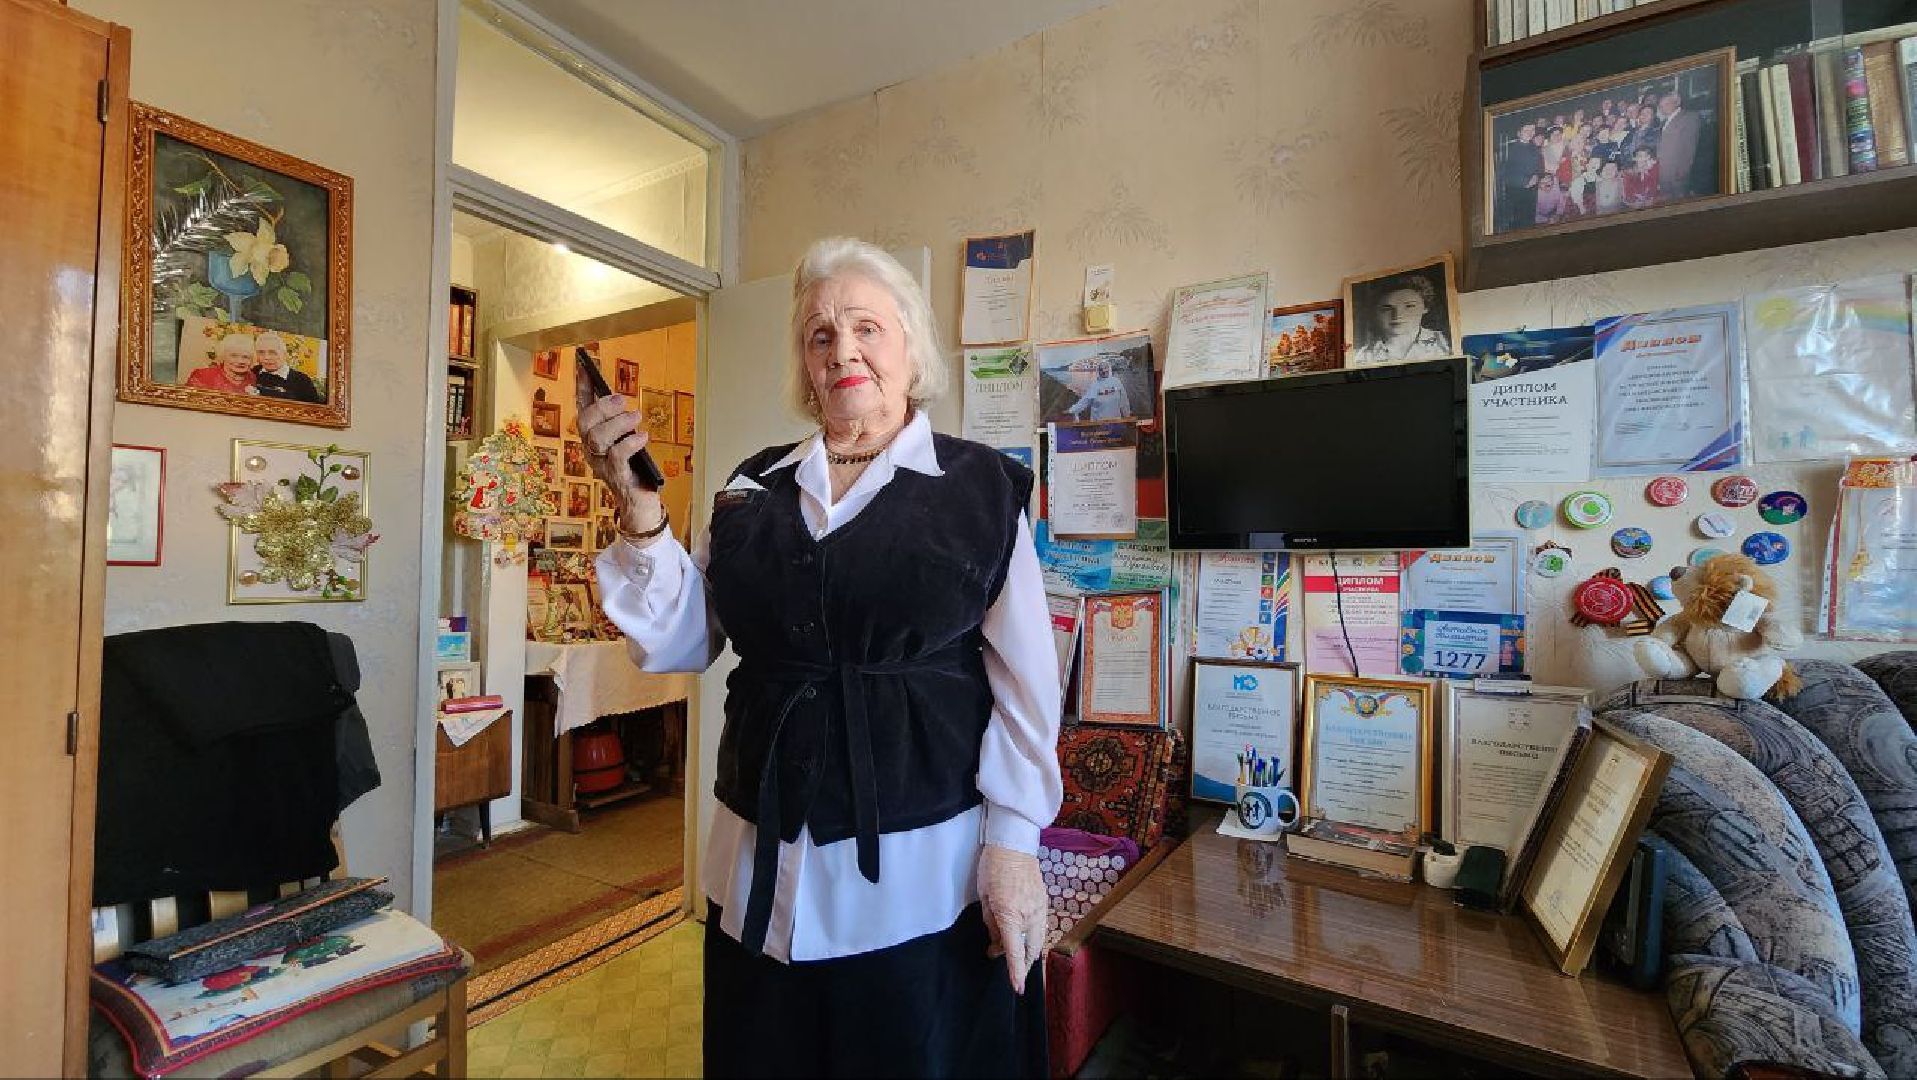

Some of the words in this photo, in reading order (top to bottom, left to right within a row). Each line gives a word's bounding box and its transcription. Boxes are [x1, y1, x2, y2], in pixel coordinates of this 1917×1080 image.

[1493, 382, 1557, 396] ДИПЛОМ
[1482, 395, 1569, 408] УЧАСТНИКА
[1433, 650, 1487, 670] 1277
